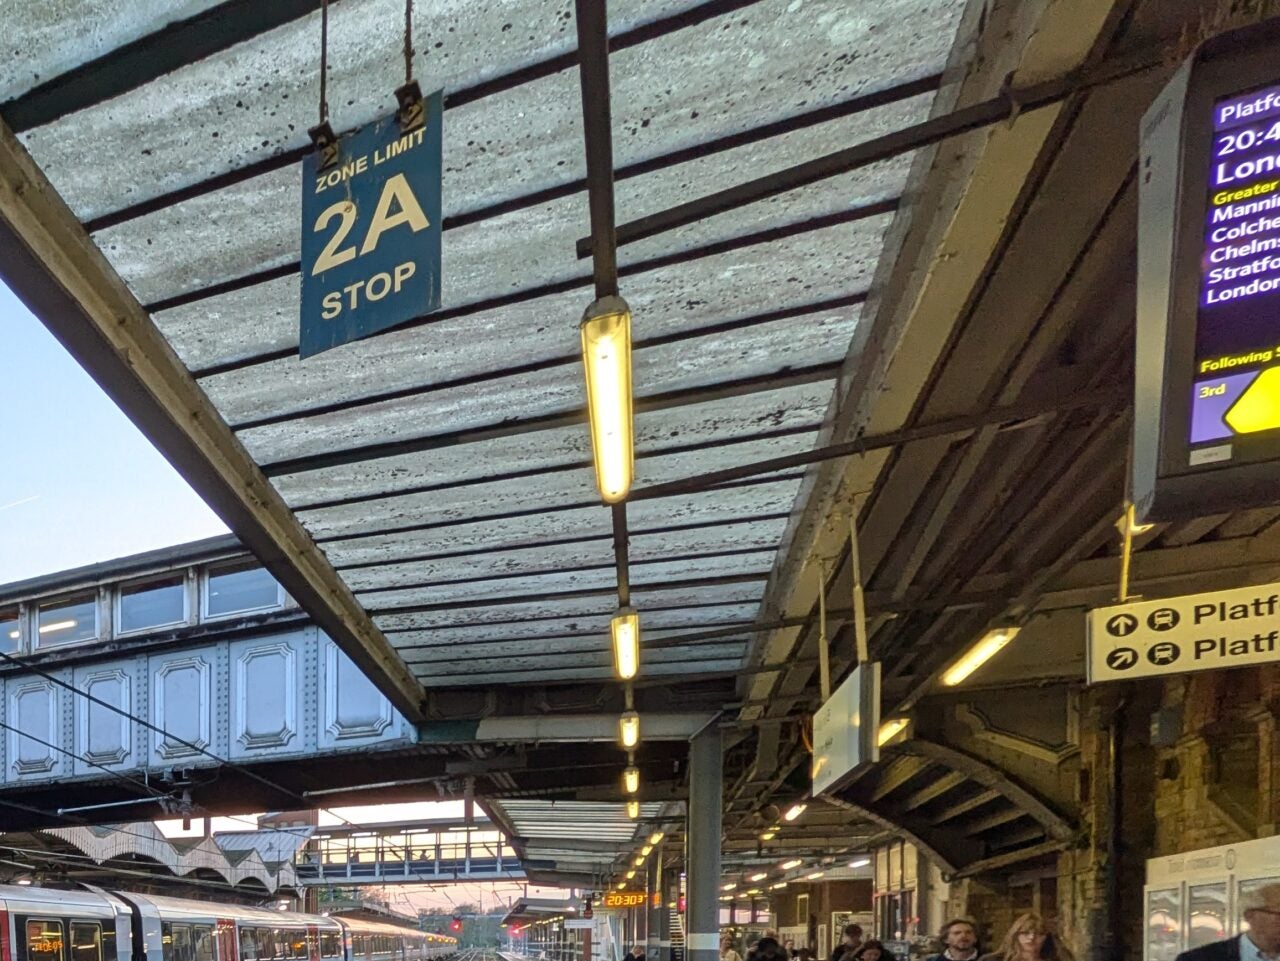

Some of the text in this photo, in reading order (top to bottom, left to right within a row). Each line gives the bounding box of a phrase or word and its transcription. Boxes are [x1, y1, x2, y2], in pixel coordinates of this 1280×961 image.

[1217, 121, 1280, 156] 20:4
[315, 127, 427, 194] ZONE LIMIT
[1216, 153, 1280, 185] Lon
[1213, 179, 1280, 206] Greater
[1212, 193, 1280, 224] Manni
[312, 173, 431, 276] 2A
[1211, 216, 1280, 243] Colche
[1208, 255, 1280, 284] Stratfo
[321, 261, 417, 320] STOP
[1199, 350, 1273, 373] Following
[1199, 383, 1227, 398] 3rd
[607, 895, 637, 906] 20:30
